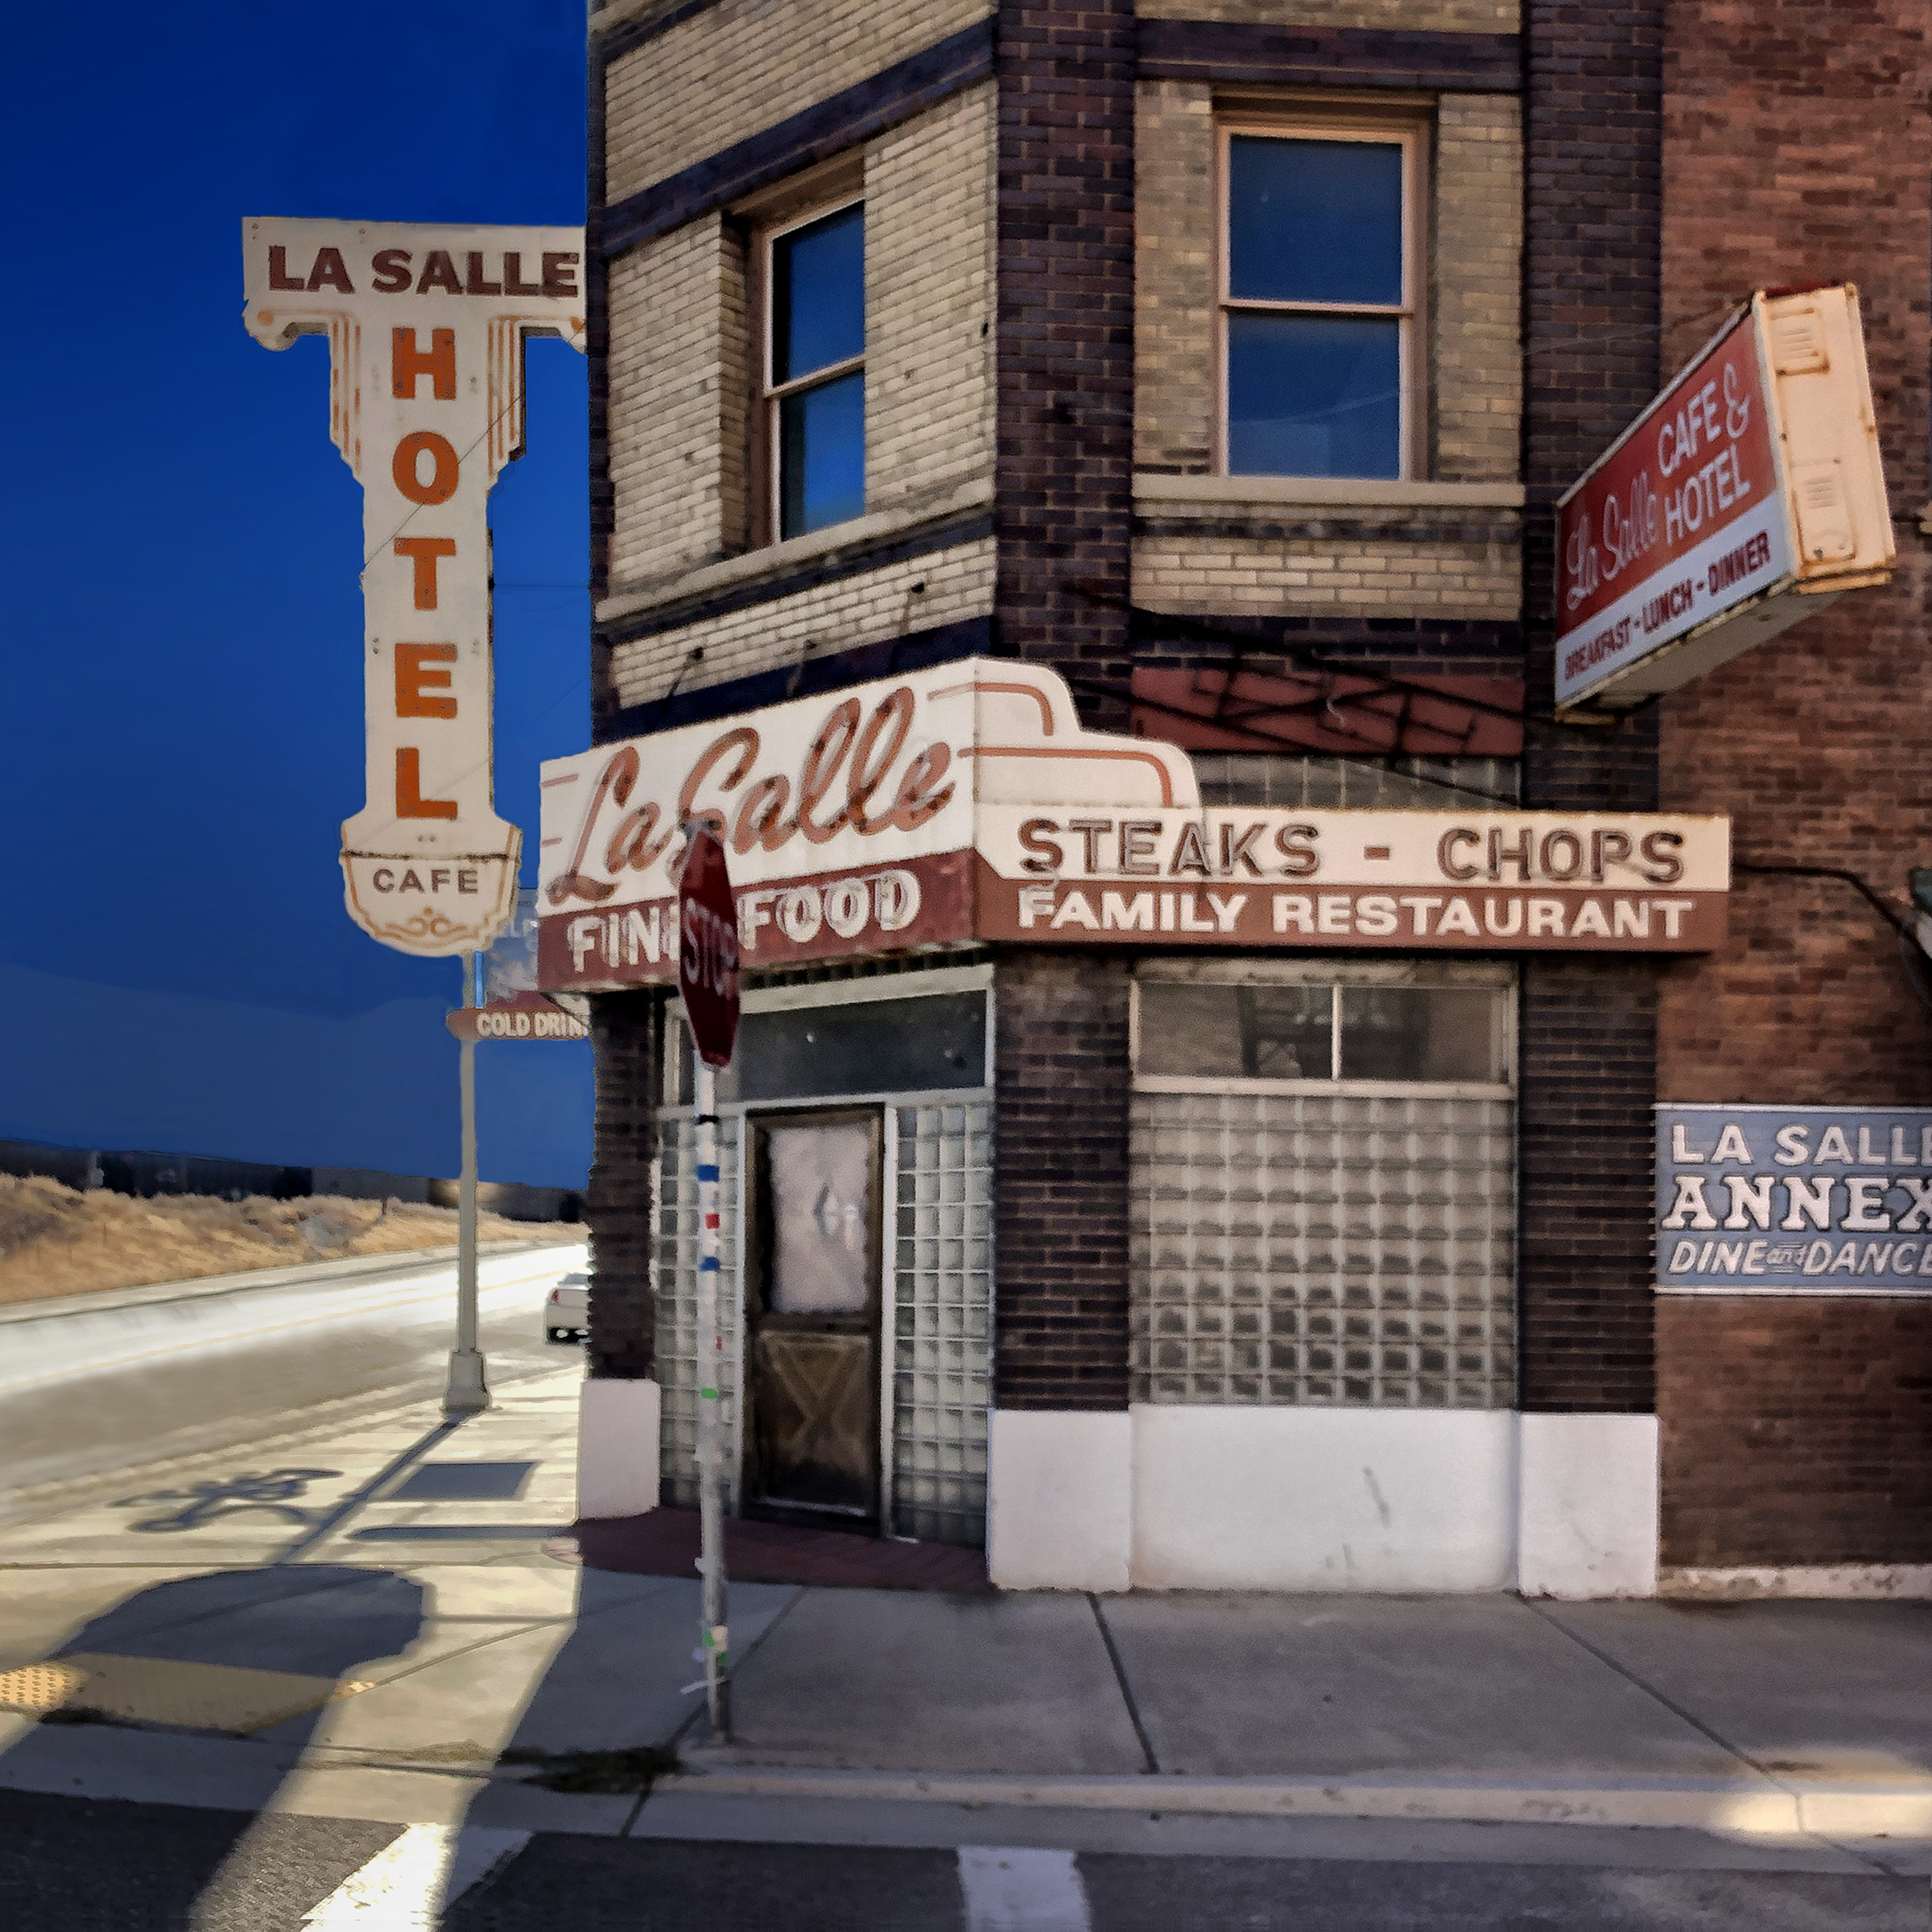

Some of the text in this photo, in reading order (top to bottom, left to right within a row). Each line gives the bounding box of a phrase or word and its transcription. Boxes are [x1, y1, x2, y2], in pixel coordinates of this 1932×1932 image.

[268, 245, 580, 298] LA SALLE
[1658, 380, 1721, 477] CAFE
[1664, 444, 1751, 547] HOTEL
[391, 326, 460, 820] HOTEL
[1707, 530, 1770, 597] DINNER
[546, 686, 955, 906] La Salle
[372, 868, 478, 895] CAFE
[1018, 817, 1322, 878] STEAKS
[1436, 826, 1686, 885] CHOPS
[736, 869, 921, 950] FOOD
[1018, 888, 1694, 939] FAMILY RESTAURANT
[477, 1011, 531, 1038] COLD
[1672, 1123, 1753, 1165] LA
[1661, 1174, 1932, 1232] ANNEX
[1668, 1240, 1768, 1275] DINE
